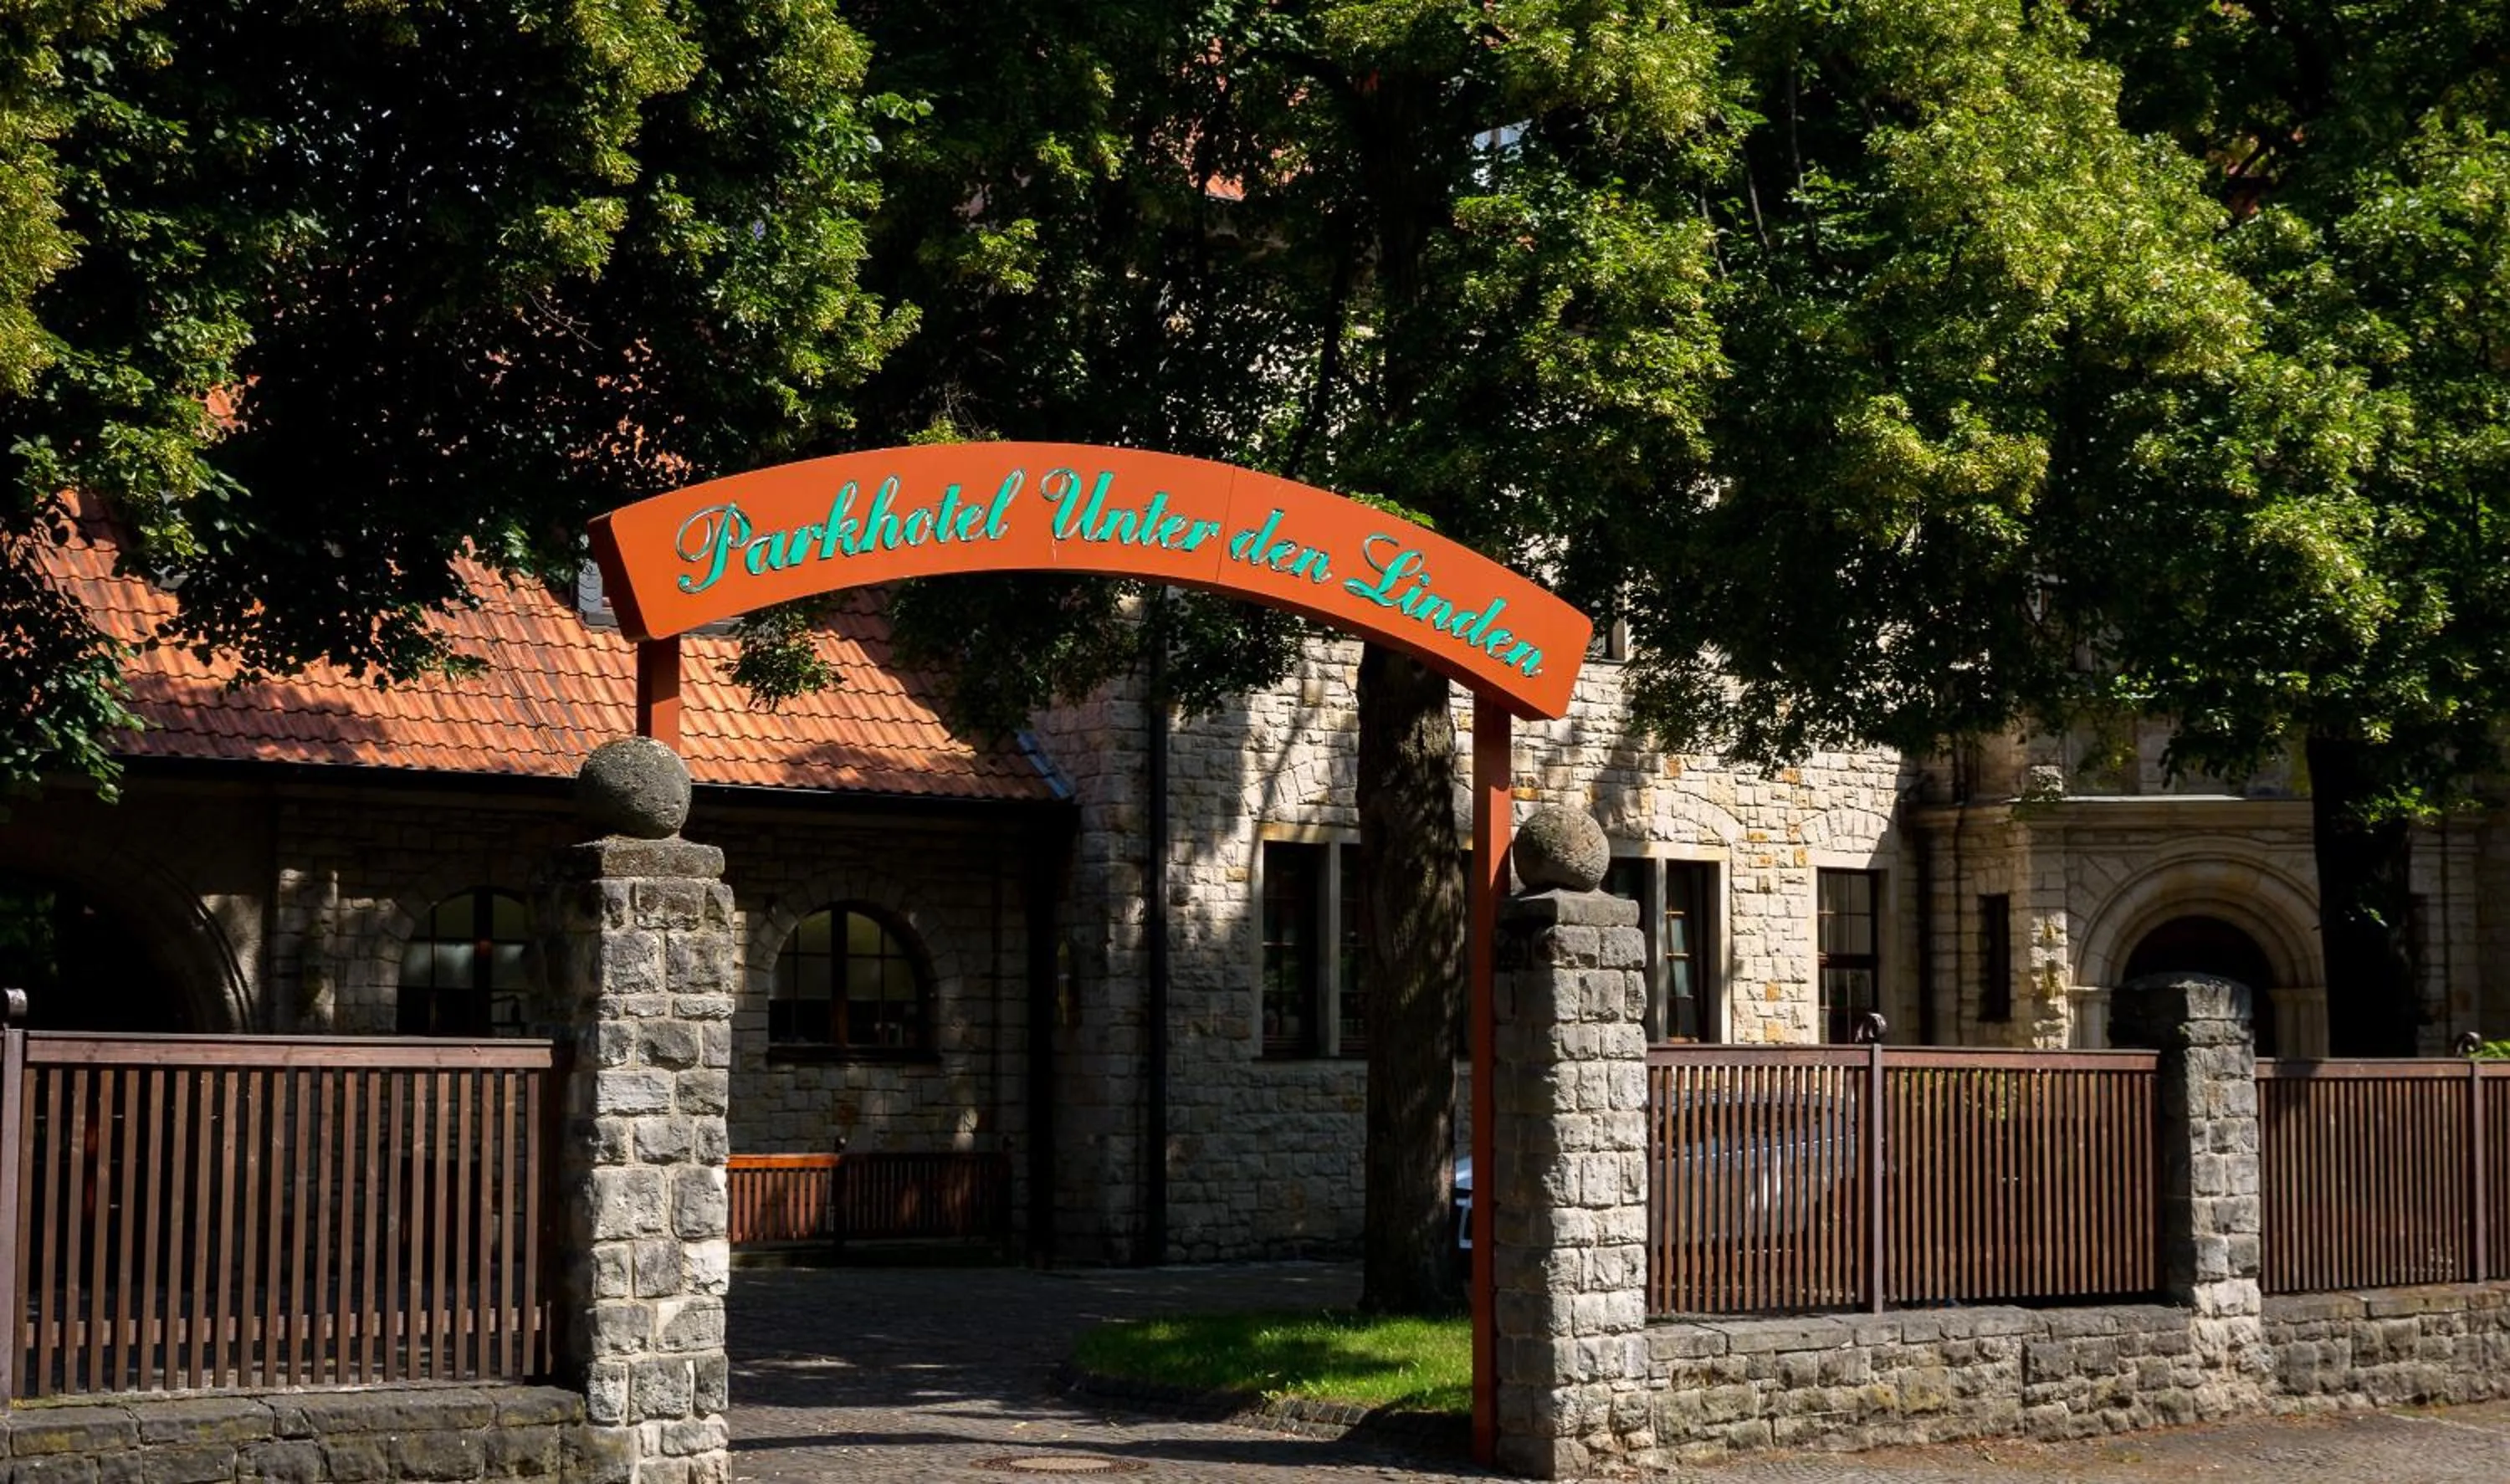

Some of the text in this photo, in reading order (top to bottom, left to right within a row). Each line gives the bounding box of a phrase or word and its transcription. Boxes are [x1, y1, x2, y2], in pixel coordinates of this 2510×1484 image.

[675, 468, 1543, 677] Parkhotel Unter den Linden
